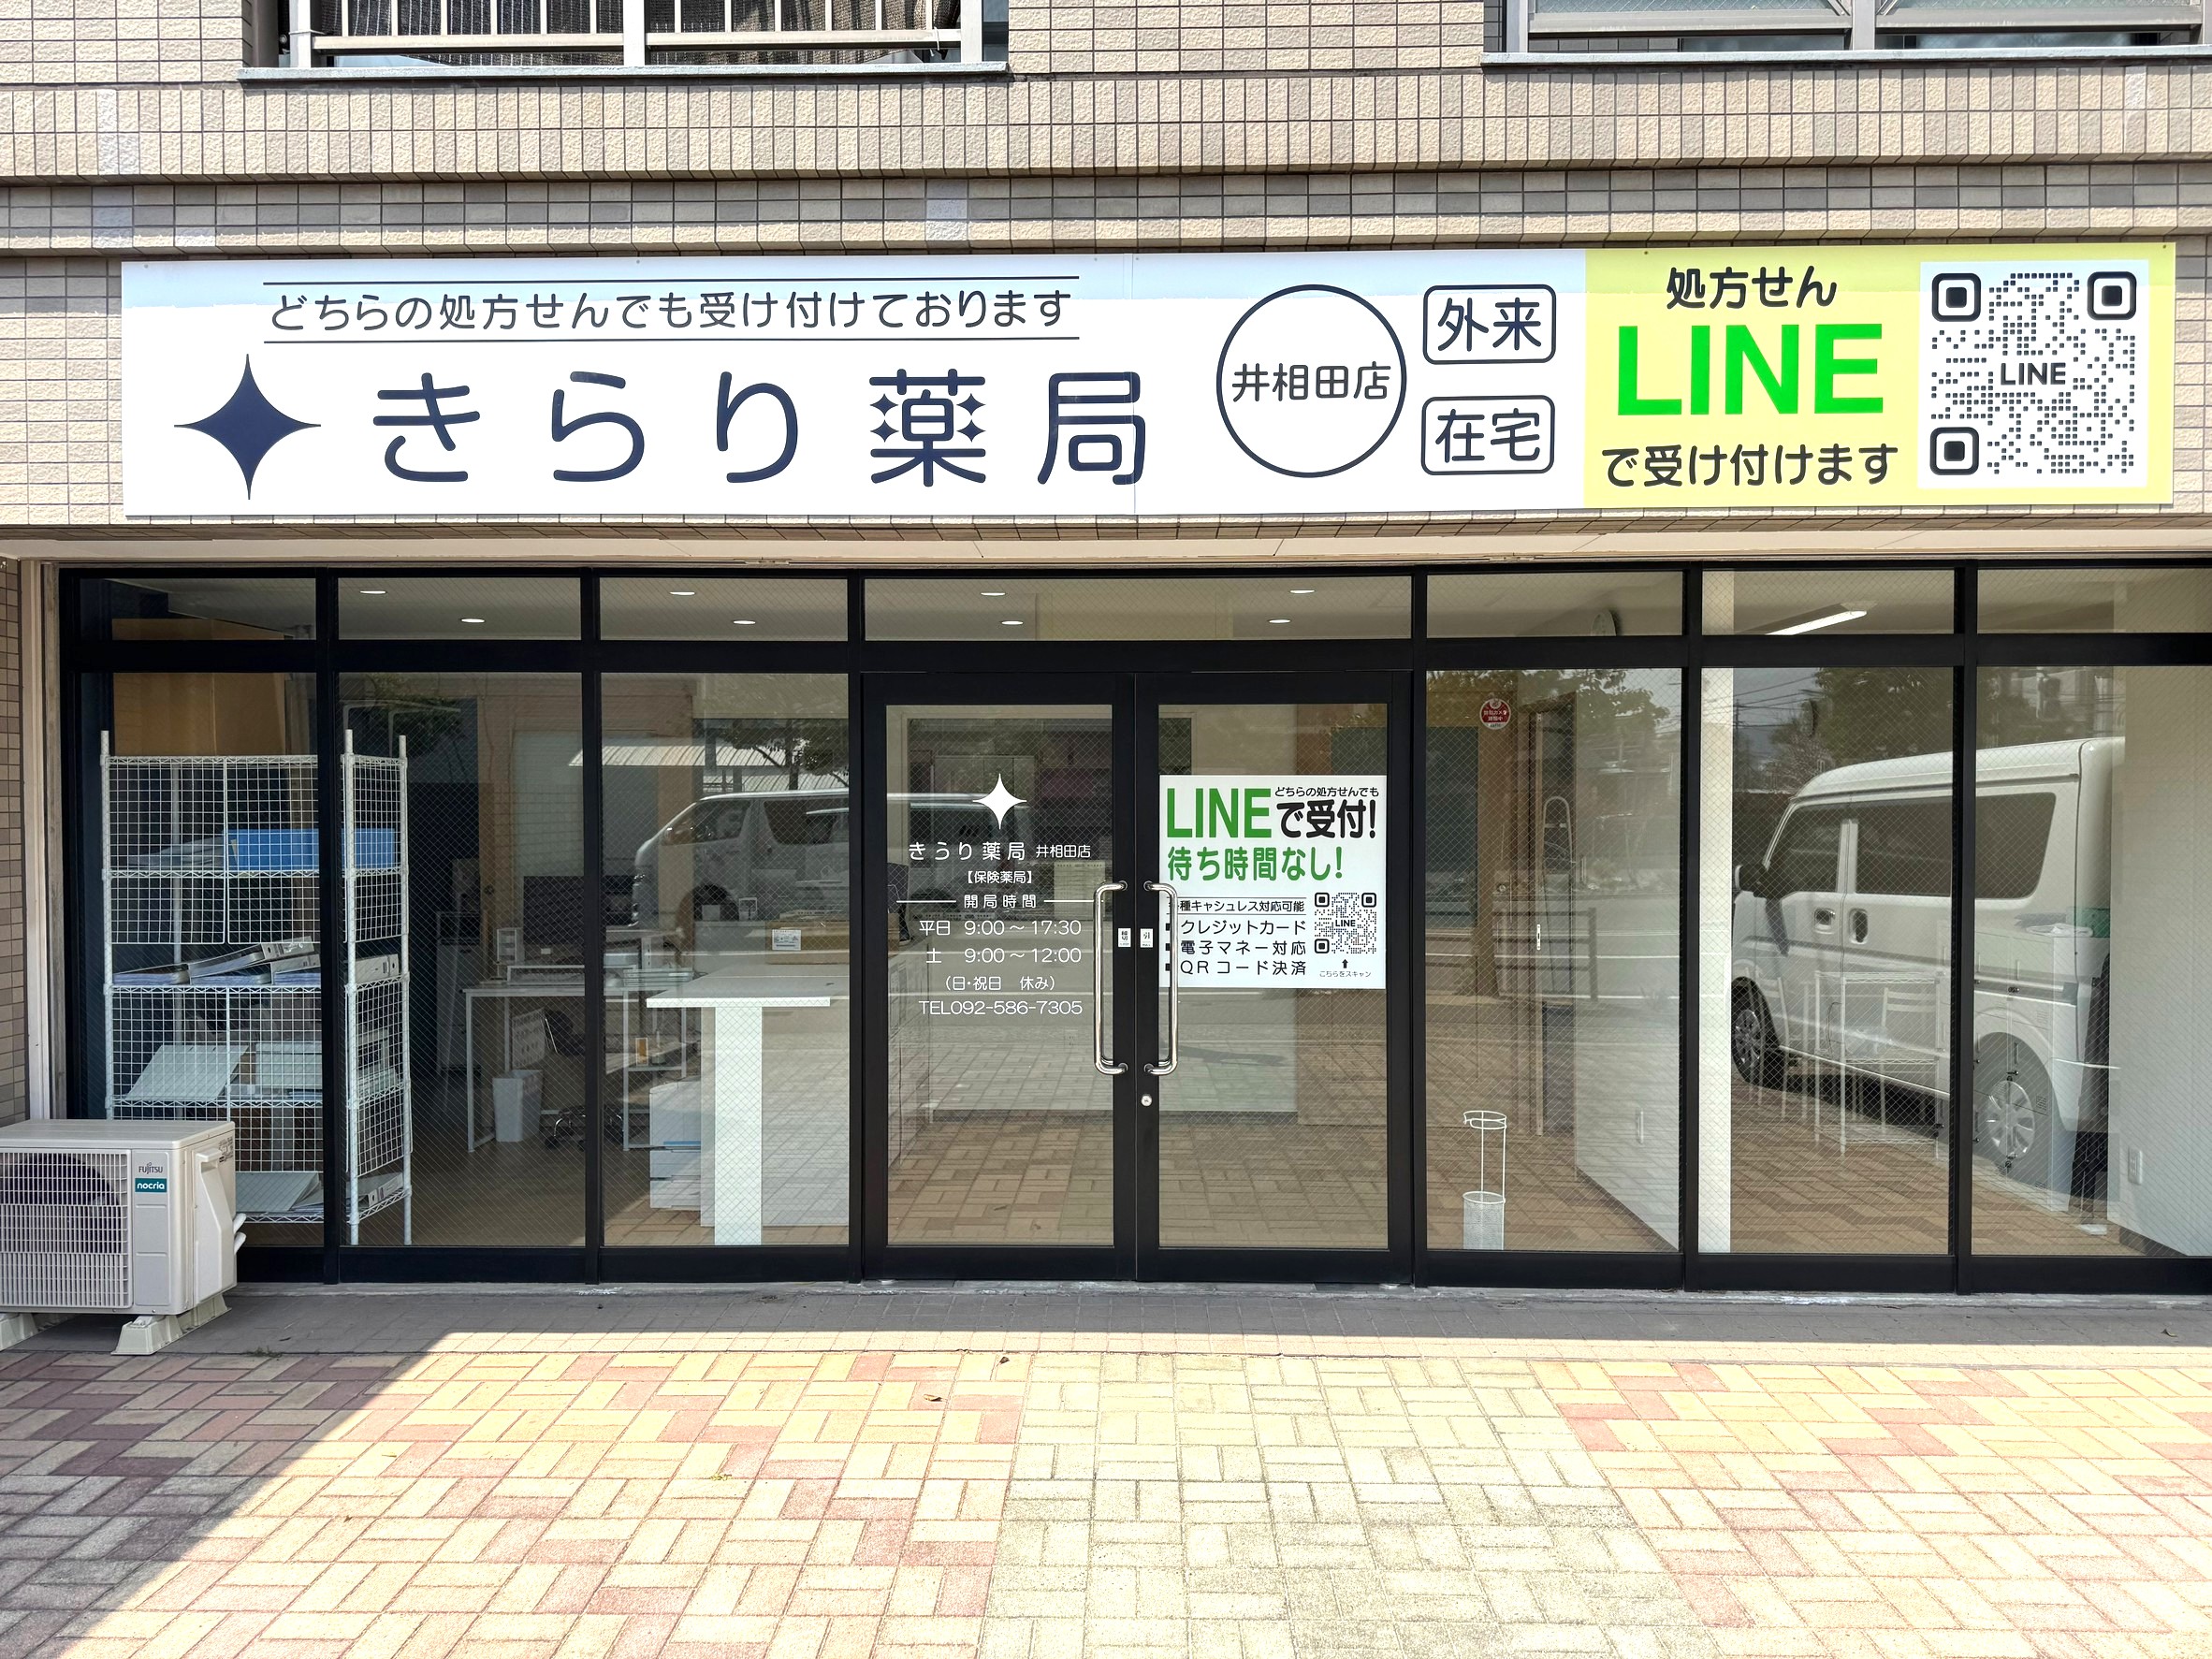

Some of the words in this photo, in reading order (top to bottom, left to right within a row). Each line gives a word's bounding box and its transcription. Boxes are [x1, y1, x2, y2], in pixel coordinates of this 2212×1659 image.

[1666, 265, 1838, 310] 処方せん
[271, 289, 1071, 331] どちらの処方せんでも受け付けております
[1437, 297, 1542, 353] 外来
[1617, 323, 1884, 416] LINE
[2000, 362, 2067, 386] LINE
[1231, 360, 1391, 403] 井相田店
[372, 368, 1146, 488] きらり薬局
[1434, 407, 1541, 464] 在宅
[1601, 443, 1899, 488] で受け付けます
[1274, 786, 1379, 797] どちらの処方せんでも
[1035, 844, 1092, 858] 井相田店
[964, 894, 1037, 909] 開局時間
[1169, 900, 1305, 912] 種キャシュレス対応可能
[919, 920, 951, 936] 平日
[1181, 919, 1306, 935] クレジットカード
[1334, 919, 1356, 927] LINE
[1180, 939, 1306, 955] 電子マネー対応
[925, 948, 942, 964] 土
[138, 1161, 164, 1175] FUJITSU
[137, 1181, 166, 1190] nocria
